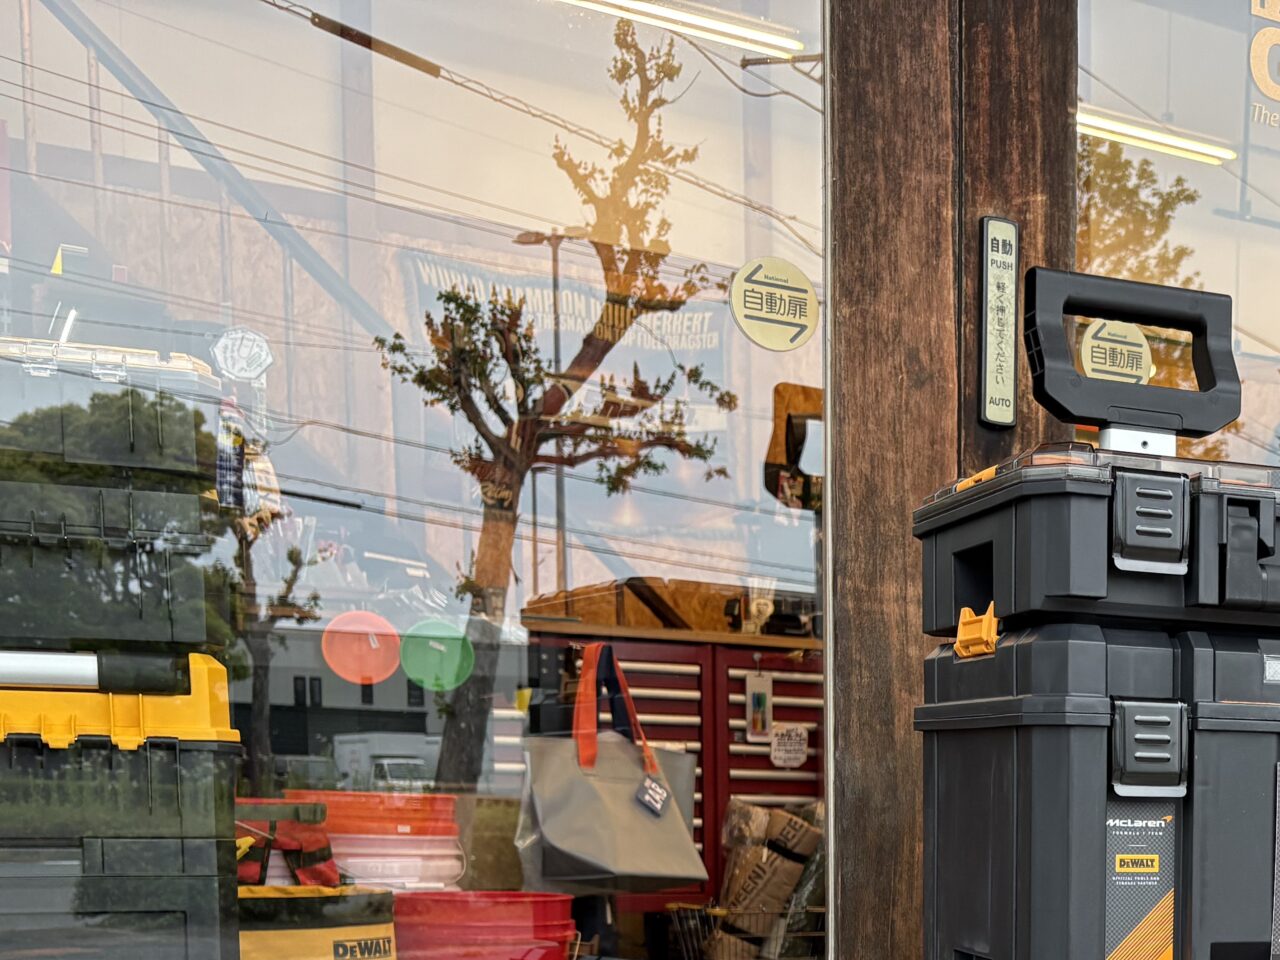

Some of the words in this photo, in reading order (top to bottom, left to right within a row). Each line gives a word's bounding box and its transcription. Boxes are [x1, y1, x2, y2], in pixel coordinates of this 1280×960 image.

[1252, 102, 1279, 127] The
[989, 236, 1013, 256] 自動
[990, 258, 1013, 271] PUSH
[743, 288, 808, 319] 自動扉
[1090, 345, 1143, 371] 自動扉
[989, 395, 1011, 408] AUTO
[1106, 819, 1165, 827] McLaren
